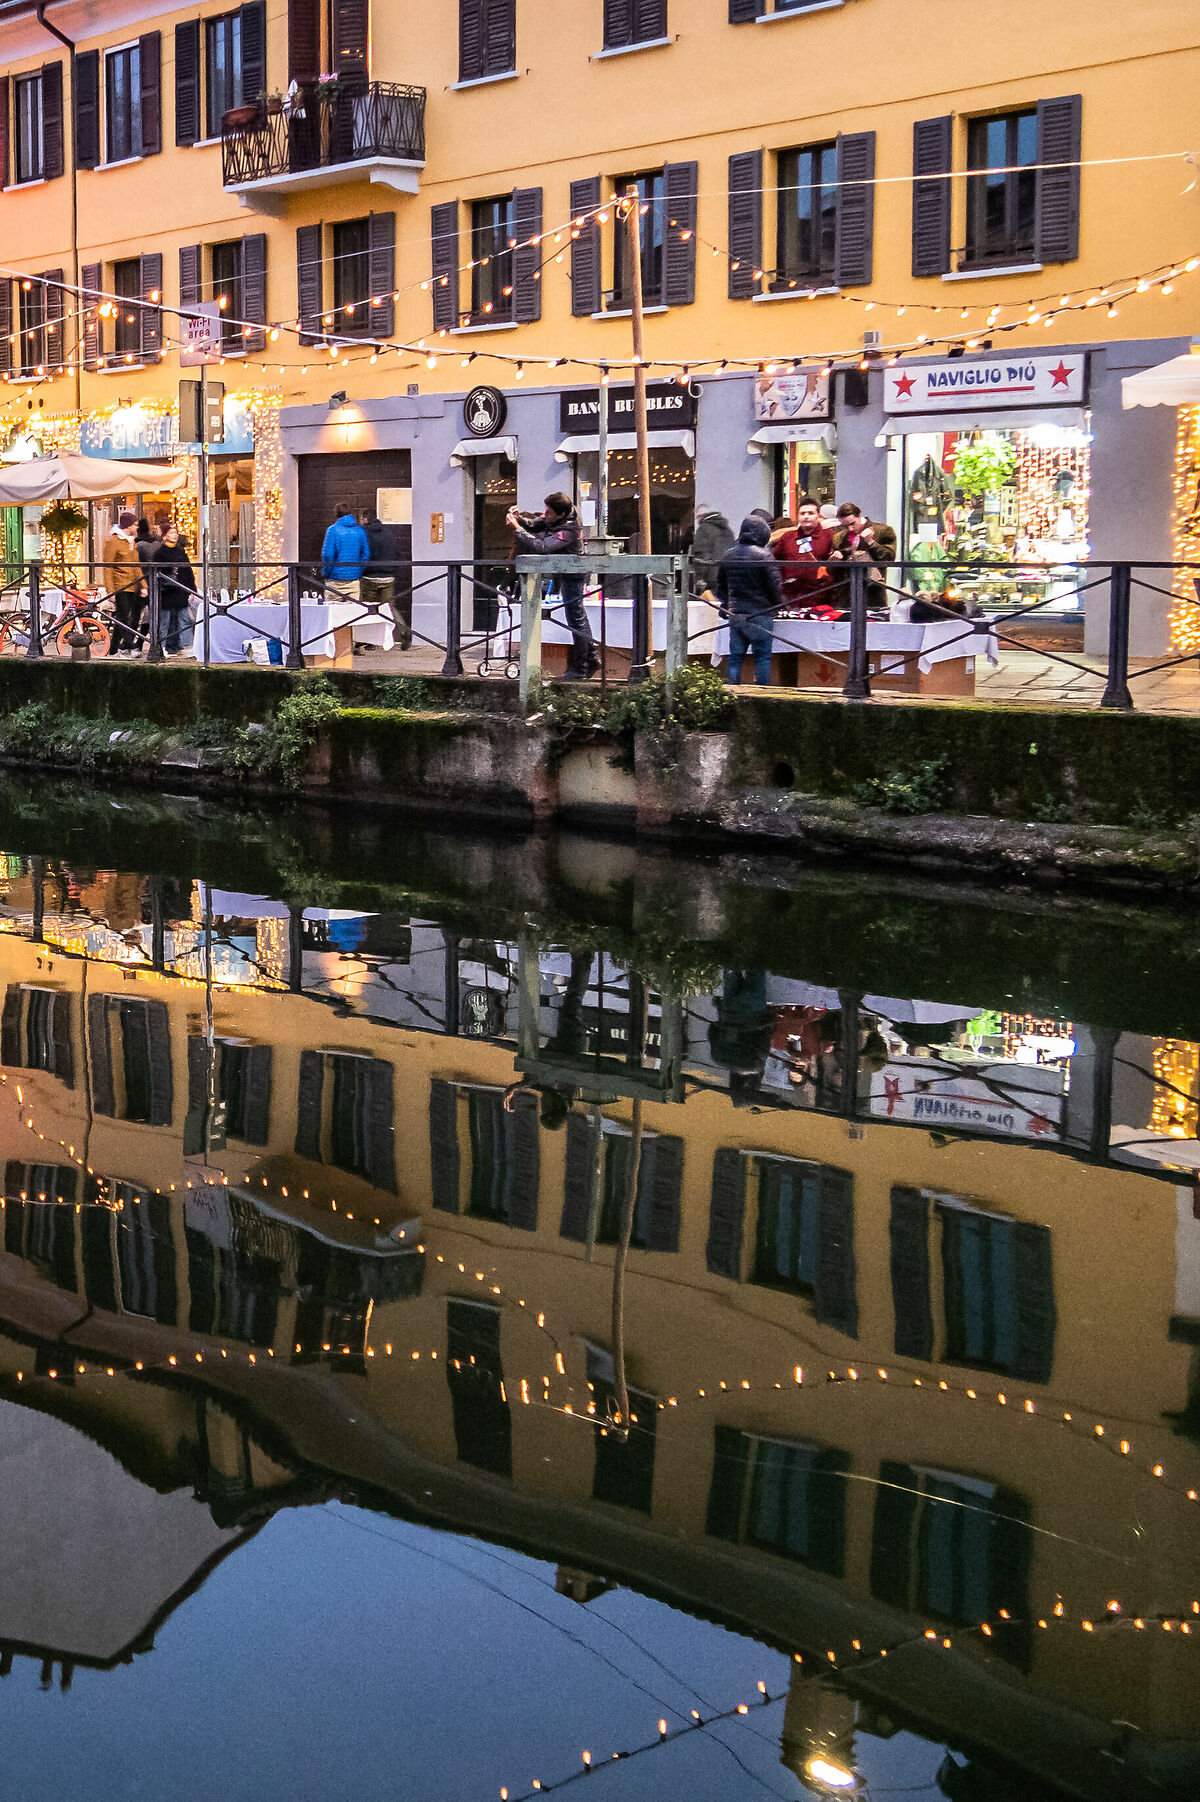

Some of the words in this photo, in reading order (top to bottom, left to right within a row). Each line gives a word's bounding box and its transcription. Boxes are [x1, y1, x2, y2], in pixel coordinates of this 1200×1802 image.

[188, 328, 210, 339] area
[927, 368, 1001, 388] NAVIGLIO
[568, 401, 601, 416] BAN
[614, 395, 683, 413] BUBLES
